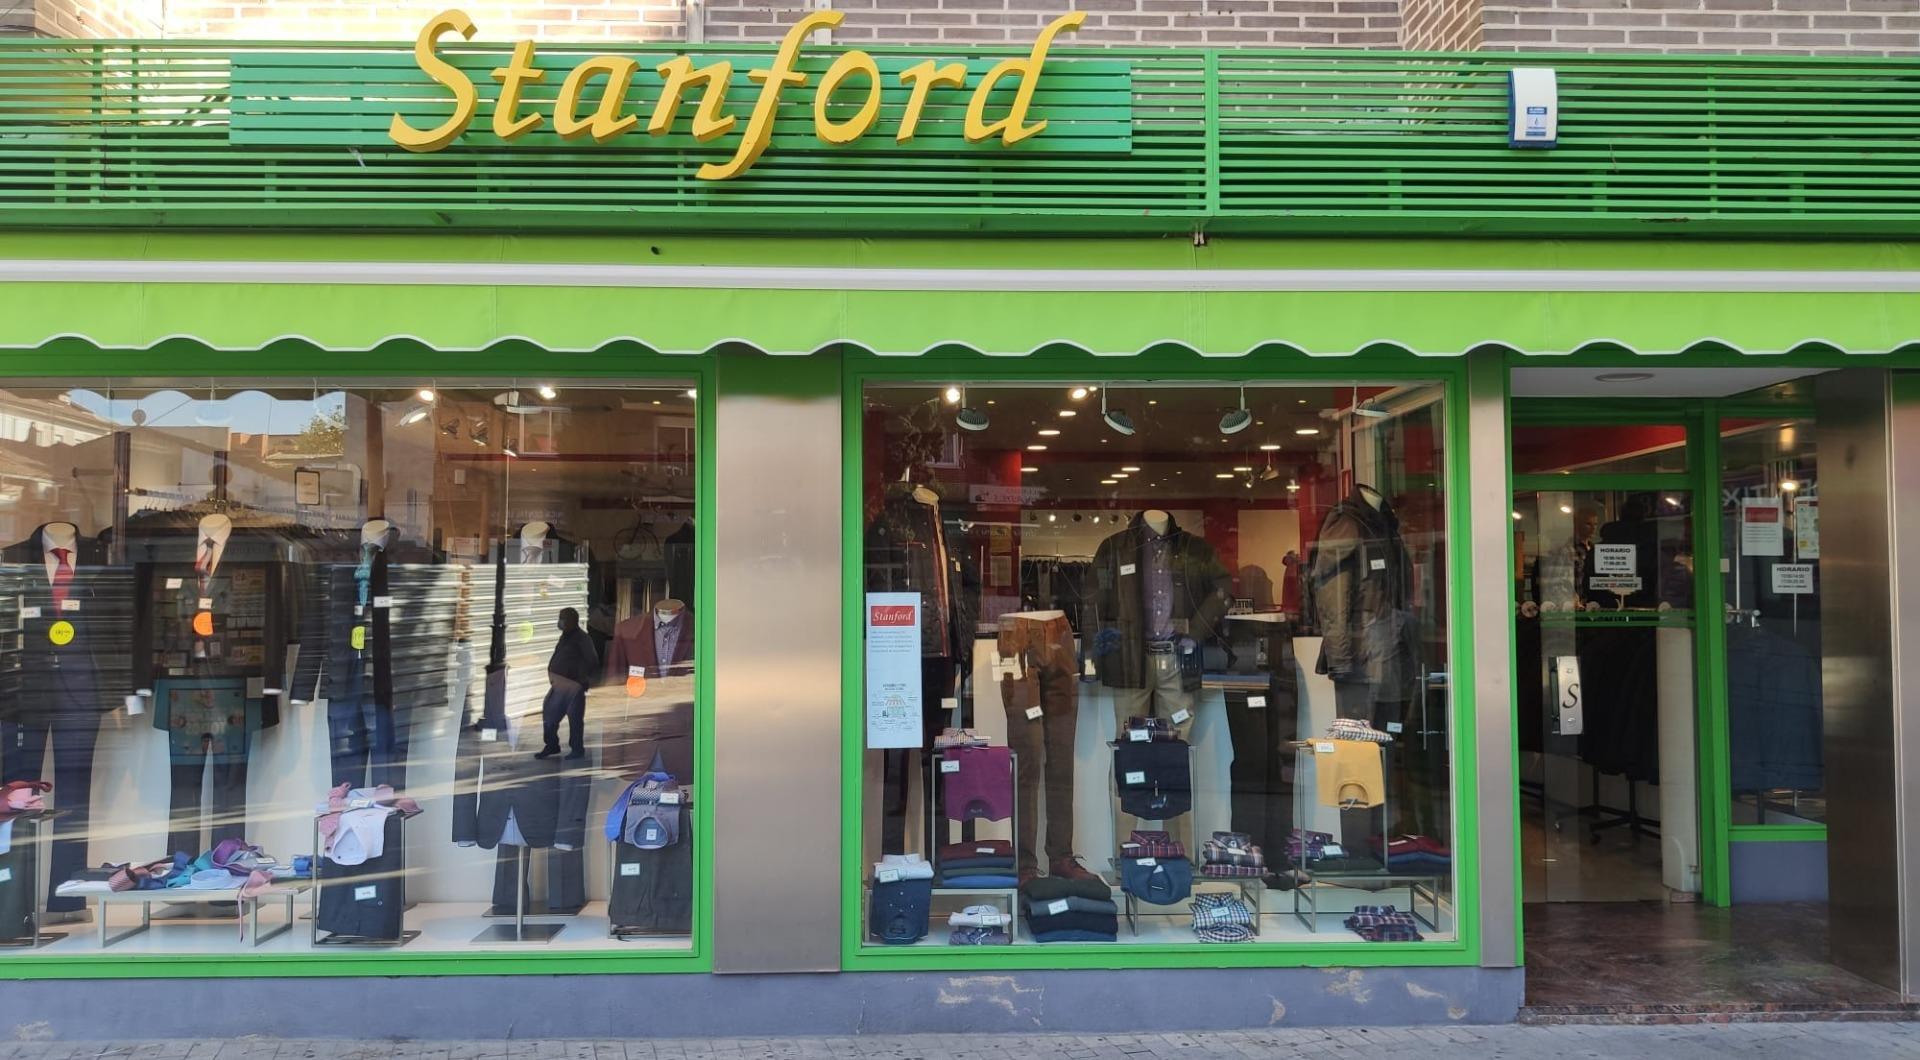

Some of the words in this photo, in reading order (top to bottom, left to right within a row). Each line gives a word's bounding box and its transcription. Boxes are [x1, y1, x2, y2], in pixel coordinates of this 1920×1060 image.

[388, 9, 1087, 180] Stanford
[873, 609, 914, 624] Stanford
[1562, 683, 1579, 708] S
